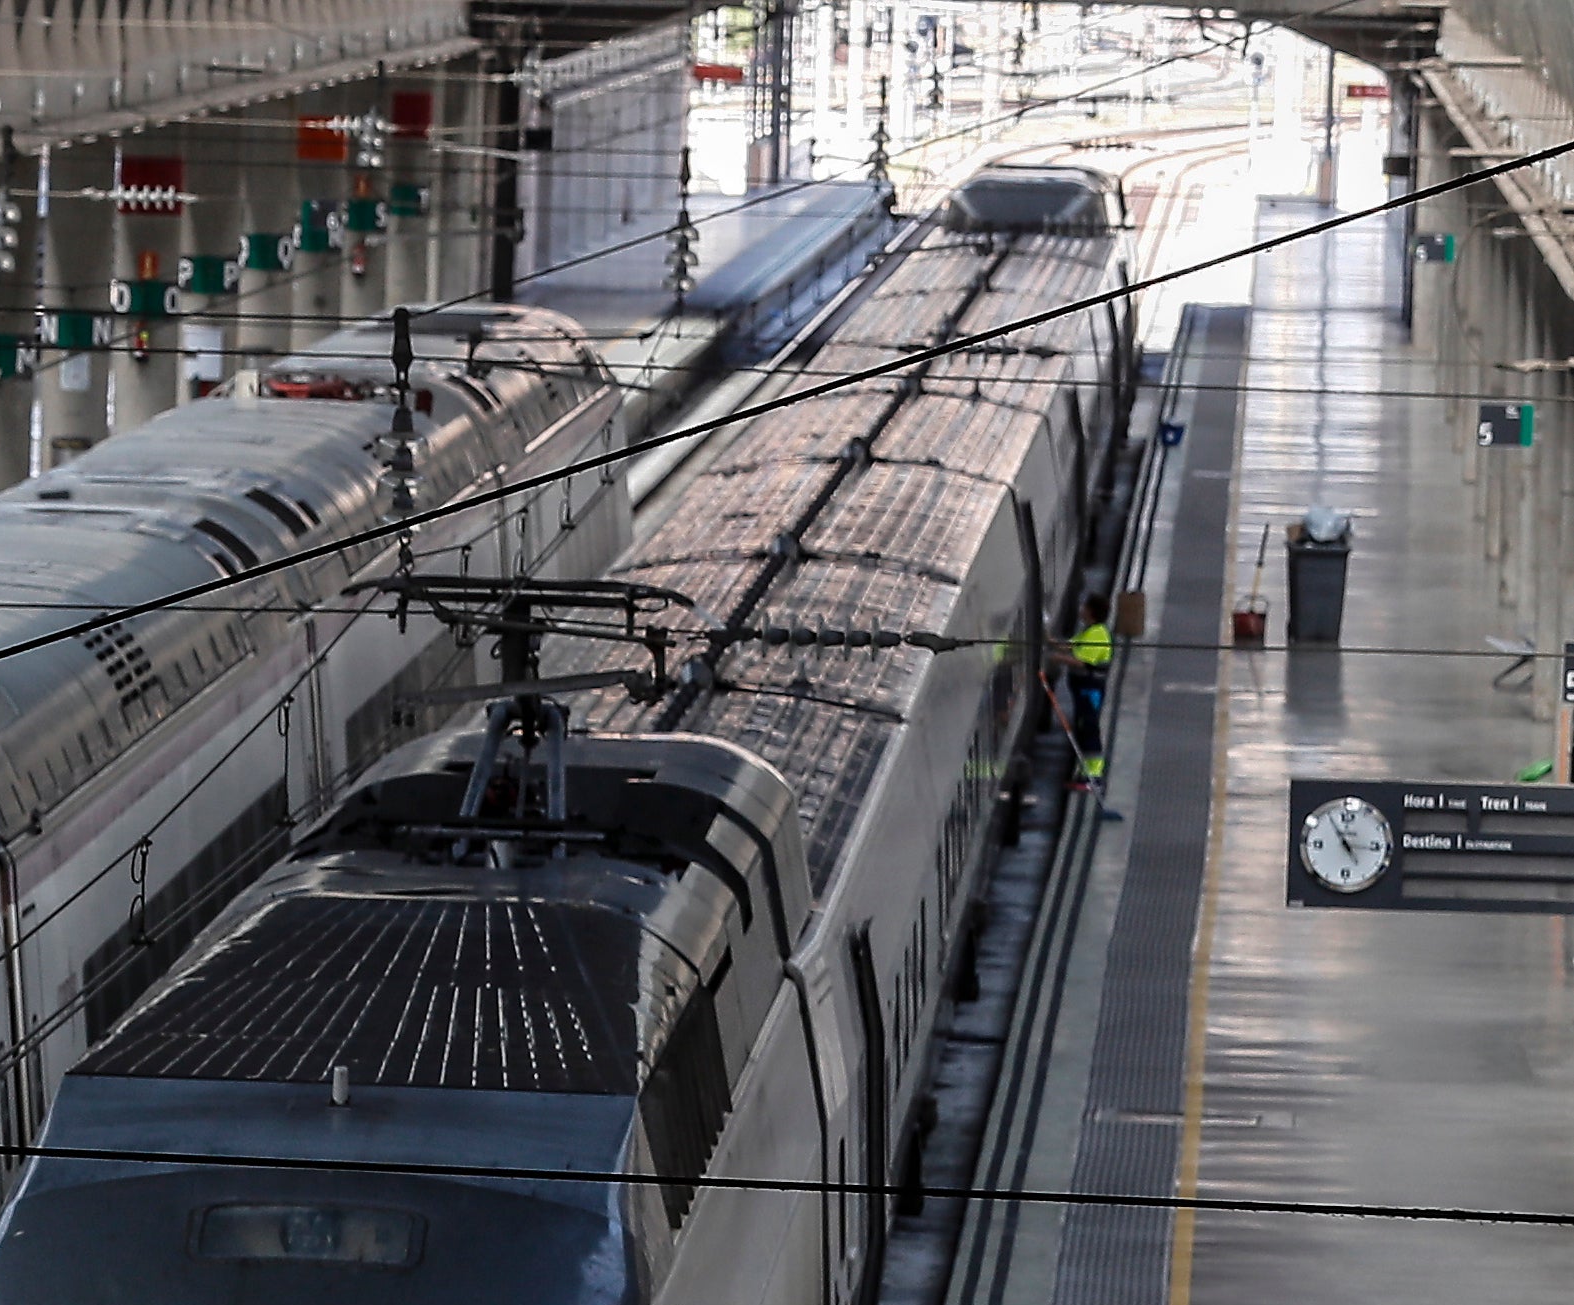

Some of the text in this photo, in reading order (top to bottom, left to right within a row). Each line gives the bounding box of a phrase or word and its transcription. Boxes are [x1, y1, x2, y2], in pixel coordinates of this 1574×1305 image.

[177, 257, 195, 289] P
[1478, 421, 1494, 446] 5
[1404, 793, 1436, 808] Hora
[1481, 795, 1510, 811] Tren
[1403, 833, 1452, 849] Destino
